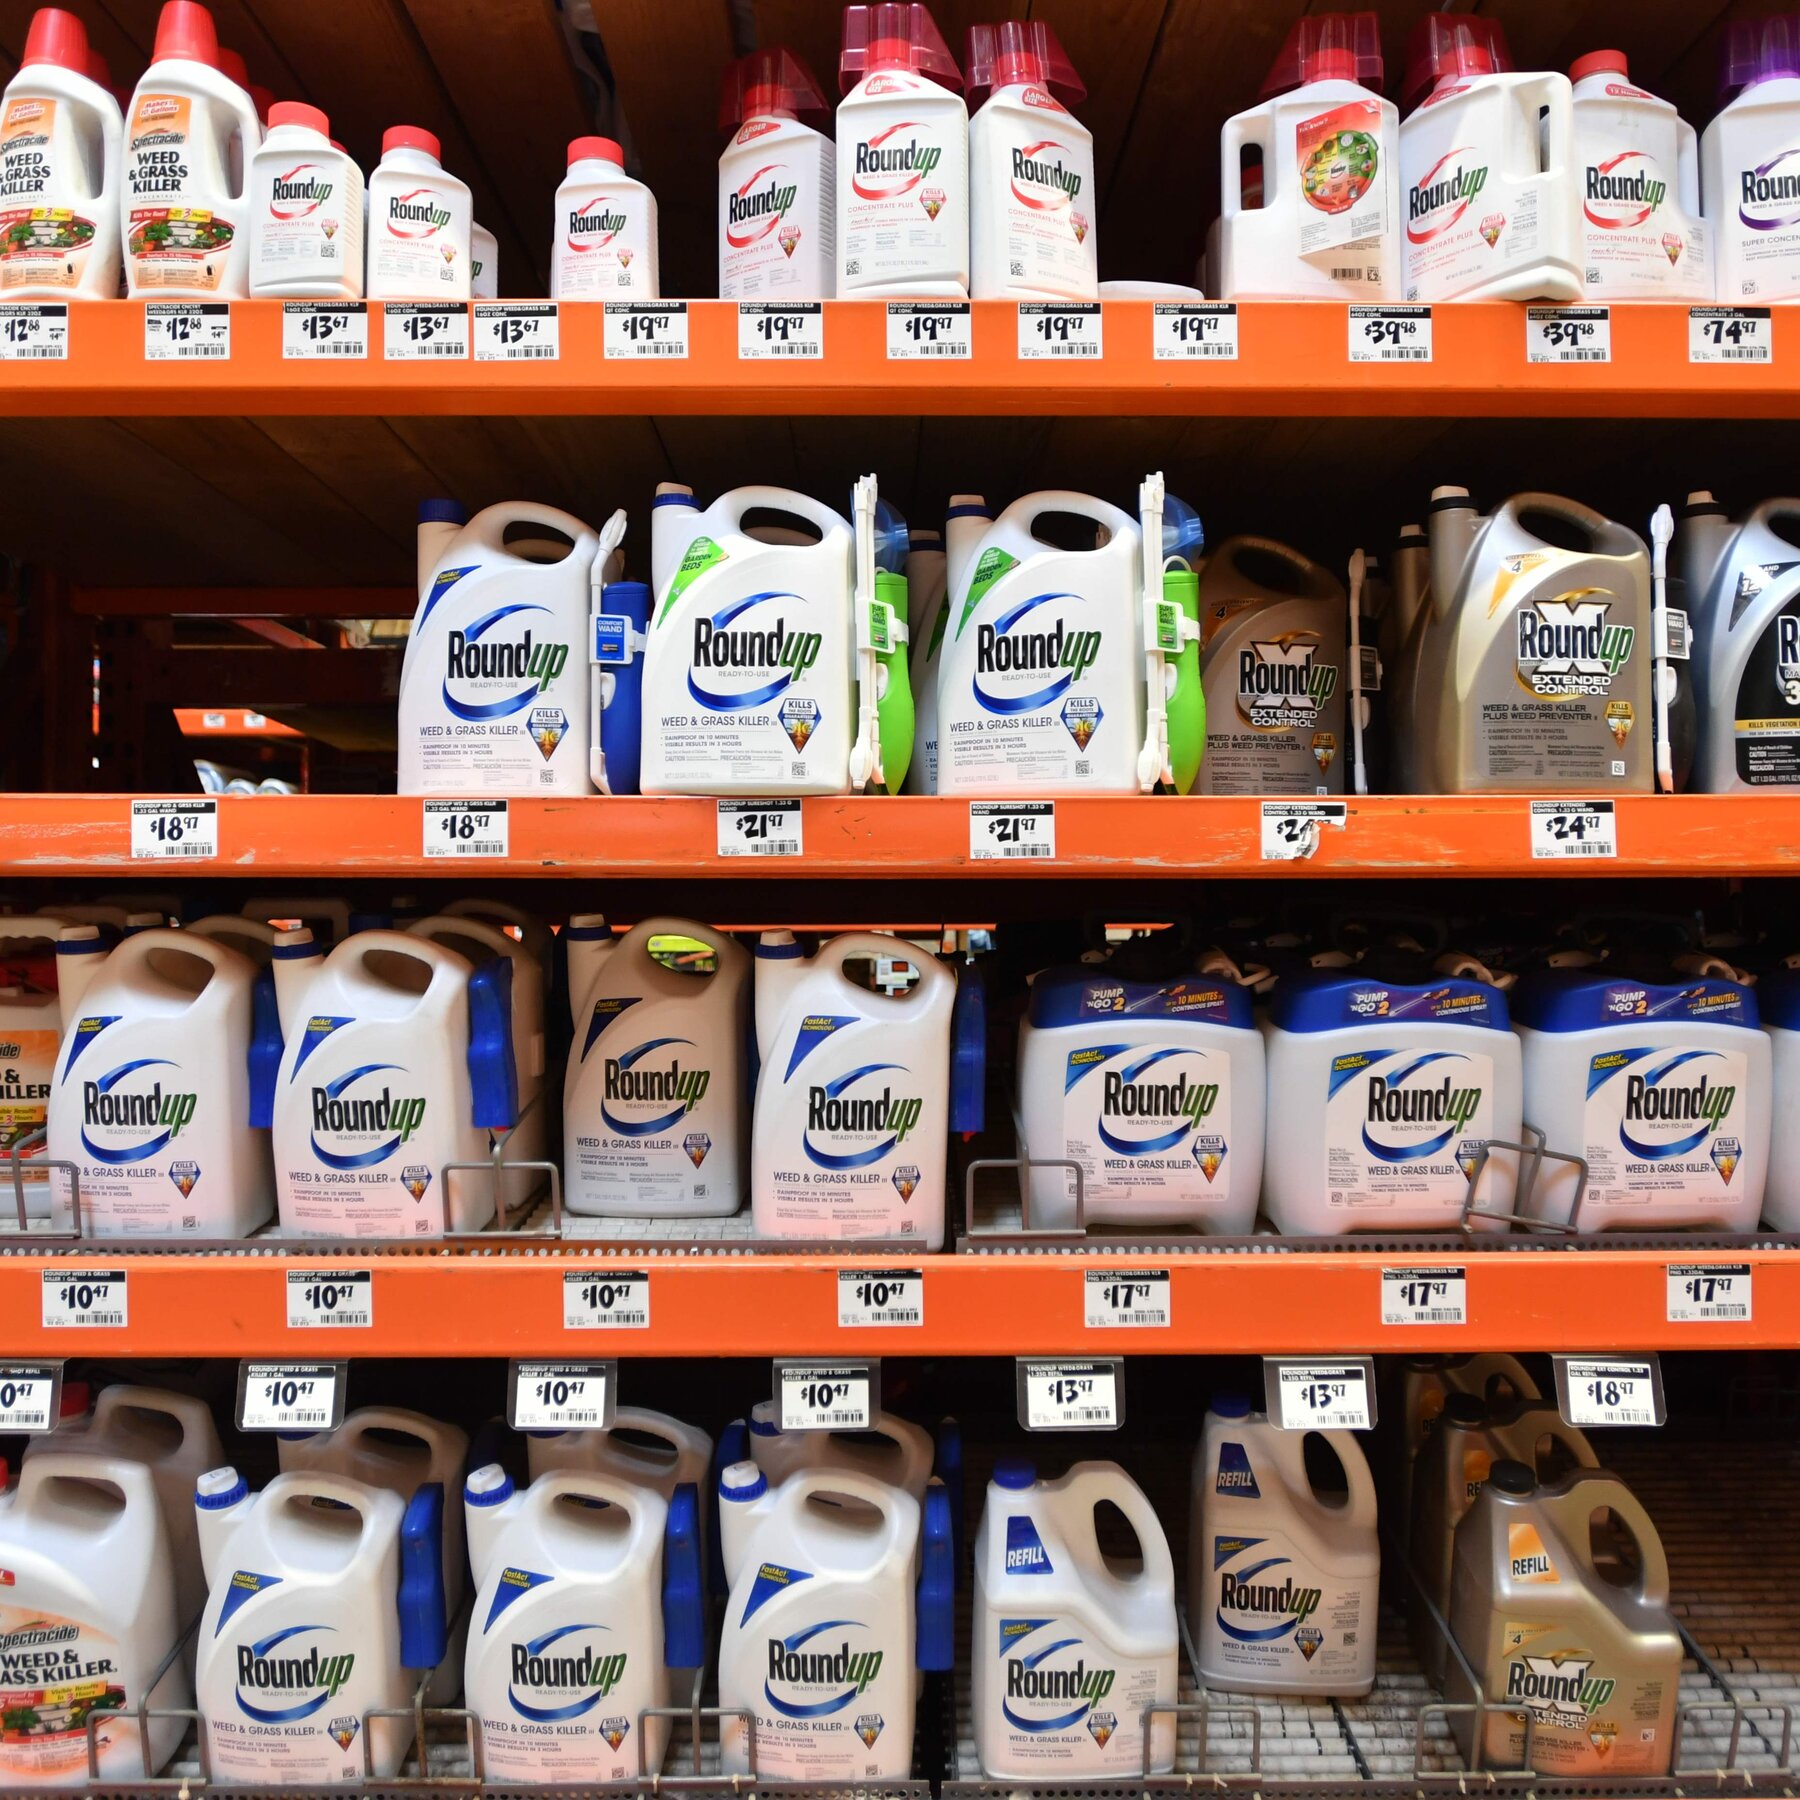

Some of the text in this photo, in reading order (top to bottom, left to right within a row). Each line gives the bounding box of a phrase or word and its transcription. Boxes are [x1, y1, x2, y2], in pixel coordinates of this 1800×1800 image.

[0, 135, 49, 155] Spectracide
[131, 133, 185, 151] Spectracide
[5, 152, 43, 168] WEED
[137, 151, 180, 165] WEED
[856, 139, 942, 179] Roundup
[5, 165, 51, 181] GRASS
[128, 164, 188, 181] & GRASS
[1012, 147, 1082, 201] Roundup
[0, 179, 44, 197] KILLER
[133, 179, 182, 193] KILLER
[272, 176, 333, 205] Roundup
[1409, 166, 1488, 220] Roundup
[1586, 166, 1666, 213] Roundup
[729, 181, 798, 220] Roundup
[847, 201, 914, 213] CONCENTRATE PLUS
[390, 196, 452, 231] Roundup
[569, 209, 627, 237] Roundup
[684, 553, 712, 563] GARDEN
[680, 561, 702, 572] BEDS
[598, 625, 623, 633] WAND
[693, 617, 822, 683] Roundup
[977, 617, 1102, 683] Roundup
[1518, 609, 1635, 676] Roundup
[448, 628, 569, 693] Roundup
[718, 670, 770, 678] READY-TO-USE
[1239, 649, 1338, 711] Roundup
[1531, 674, 1612, 686] EXTENDED
[470, 681, 518, 689] READY-TO-USE
[1535, 684, 1609, 696] CONTROL
[788, 700, 812, 709] KILLS
[1070, 699, 1094, 708] KILLS
[1482, 704, 1587, 713] WEED & GRASS KILLER
[536, 710, 560, 718] KILLS
[661, 716, 770, 727] WEED & GRASS KILLER
[1250, 708, 1318, 720] EXTENDED
[1482, 713, 1508, 721] PLUS
[1538, 713, 1592, 721] PREVENTER
[949, 717, 1053, 733] WEED & GRASS KILLER
[1252, 717, 1315, 728] CONTROL
[1765, 720, 1798, 728] VEGETATION
[419, 725, 519, 737] WEED & GRASS KILLER
[1092, 988, 1124, 999] PUMP
[1178, 991, 1219, 1005] 10 MINUTES
[1112, 997, 1125, 1011] 2
[604, 1058, 711, 1113] Roundup
[1103, 1071, 1219, 1129] Roundup
[1367, 1076, 1482, 1134] Roundup
[1625, 1074, 1736, 1132] Roundup
[83, 1081, 198, 1138] Roundup
[311, 1086, 426, 1144] Roundup
[808, 1086, 922, 1143] Roundup
[1199, 1137, 1220, 1145] KILLS
[1104, 1159, 1192, 1170] WEED & GRASS KILLER
[1625, 1163, 1710, 1174] WEED & GRASS KILLER
[288, 1172, 389, 1184] WEED & GRASS KILLER
[773, 1171, 880, 1184] WEED & GRASS KILLER
[1217, 1471, 1253, 1487] REFILL
[1007, 1546, 1045, 1569] REFILL
[1512, 1555, 1550, 1576] REFILL
[1221, 1572, 1322, 1625] Roundup
[0, 1648, 79, 1669] WEED &
[768, 1638, 884, 1694] Roundup
[237, 1644, 355, 1699] Roundup
[511, 1643, 628, 1697] Roundup
[1007, 1659, 1116, 1710] Roundup
[1507, 1660, 1616, 1708] Roundup
[483, 1719, 587, 1735] WEED & GRASS KILLER
